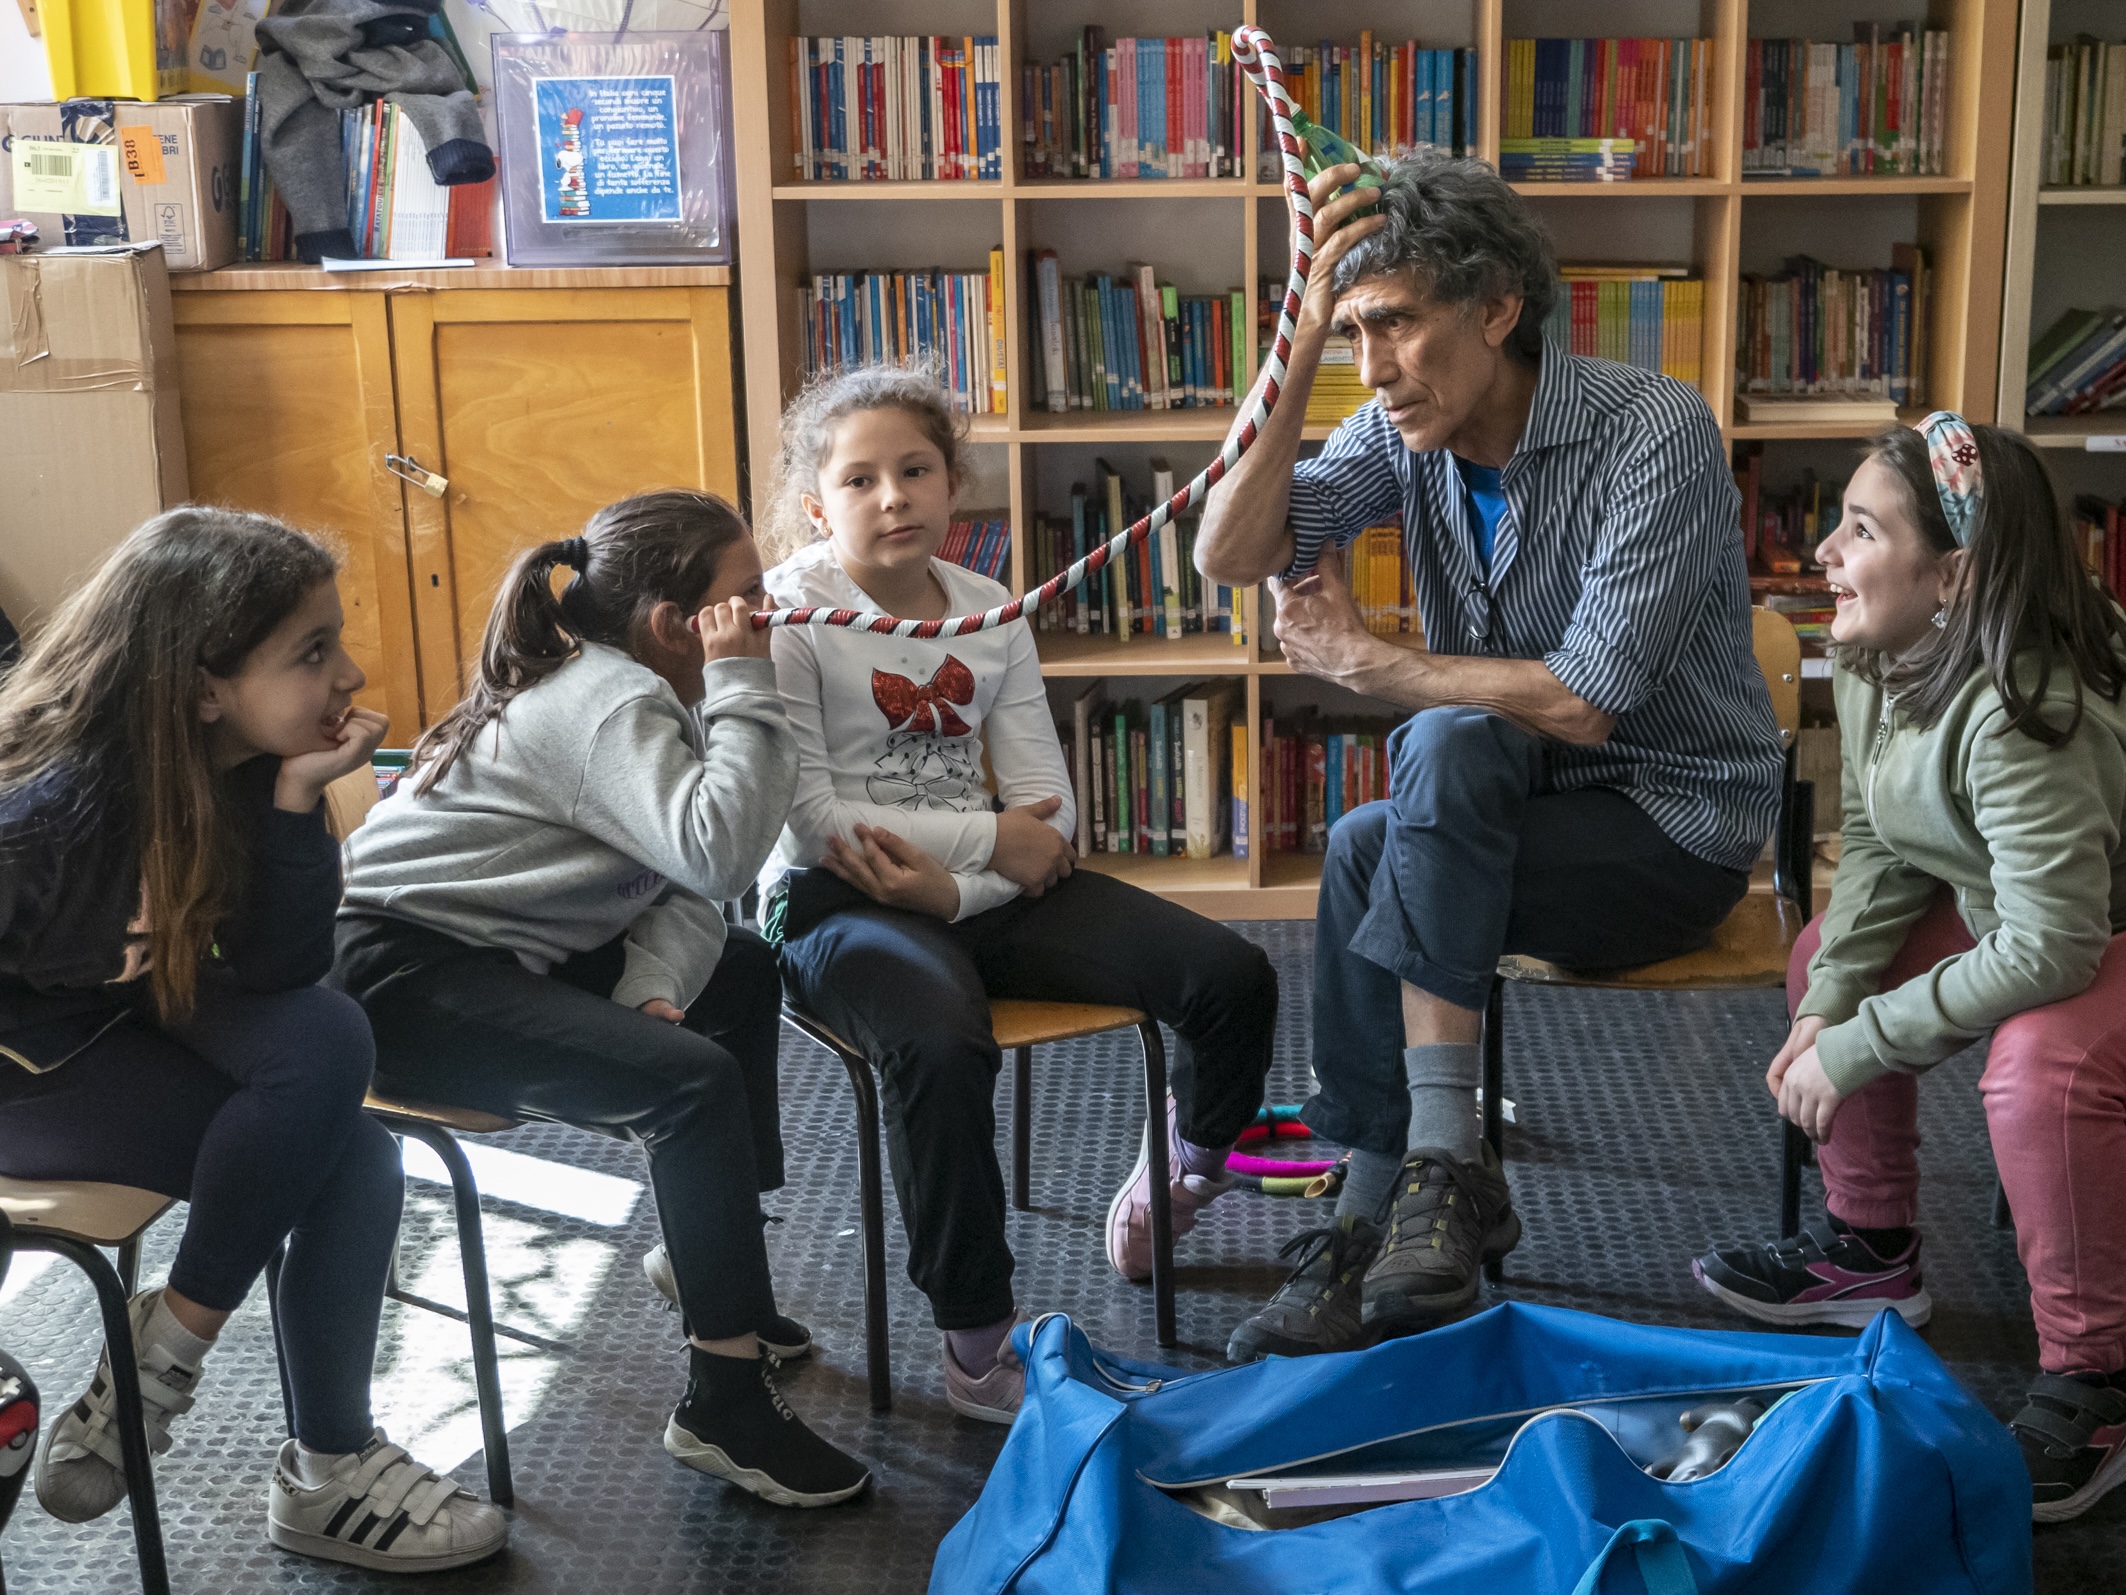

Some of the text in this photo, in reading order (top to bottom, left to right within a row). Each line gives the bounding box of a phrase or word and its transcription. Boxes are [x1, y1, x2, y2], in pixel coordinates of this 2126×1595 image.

[600, 89, 619, 97] Italia
[622, 90, 638, 99] ogni
[641, 89, 666, 98] cinque
[651, 186, 660, 194] da
